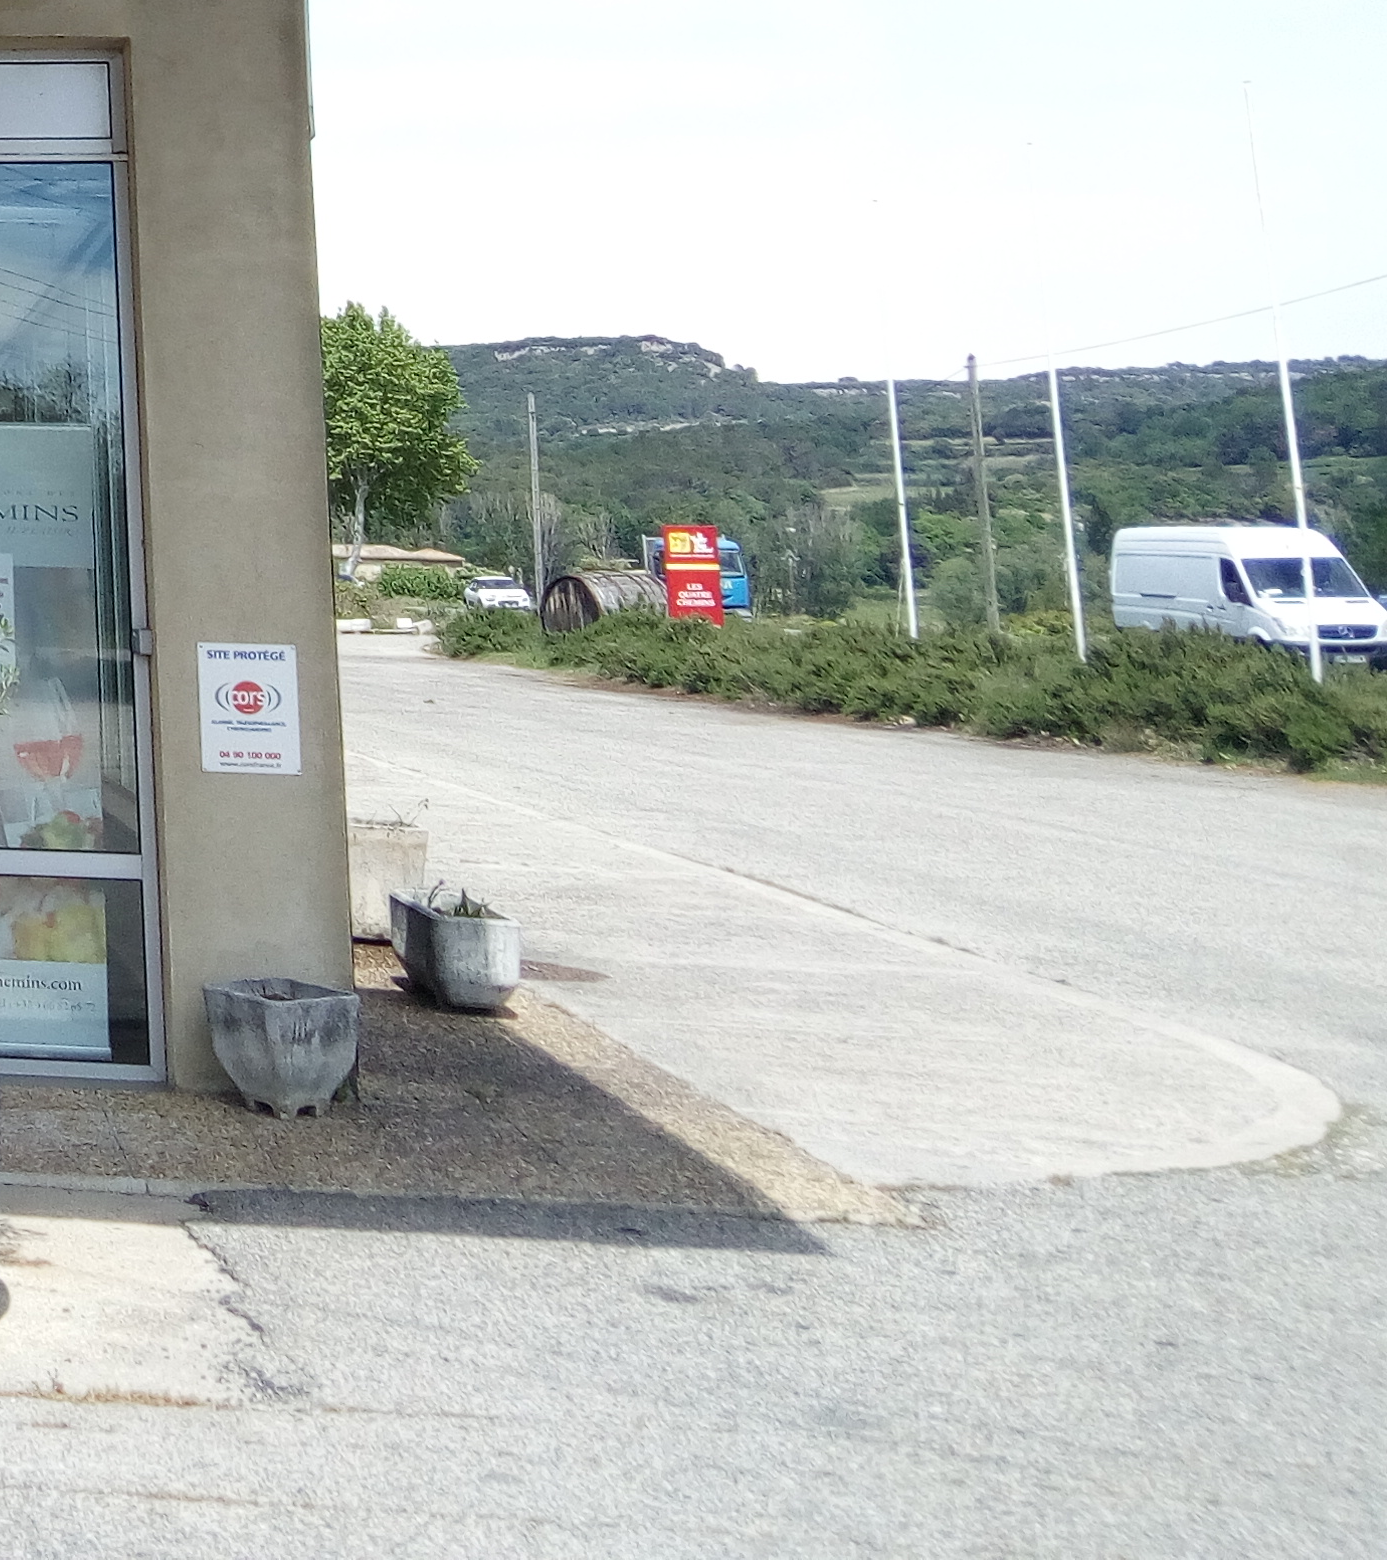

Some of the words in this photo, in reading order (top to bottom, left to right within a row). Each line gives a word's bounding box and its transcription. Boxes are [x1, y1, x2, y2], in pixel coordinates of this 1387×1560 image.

[686, 583, 703, 591] LES
[678, 591, 713, 599] QUATRE
[676, 599, 716, 608] CHEMINS
[206, 649, 231, 660] SITE
[233, 649, 286, 662] PROTÉGÉ
[231, 690, 267, 706] cors
